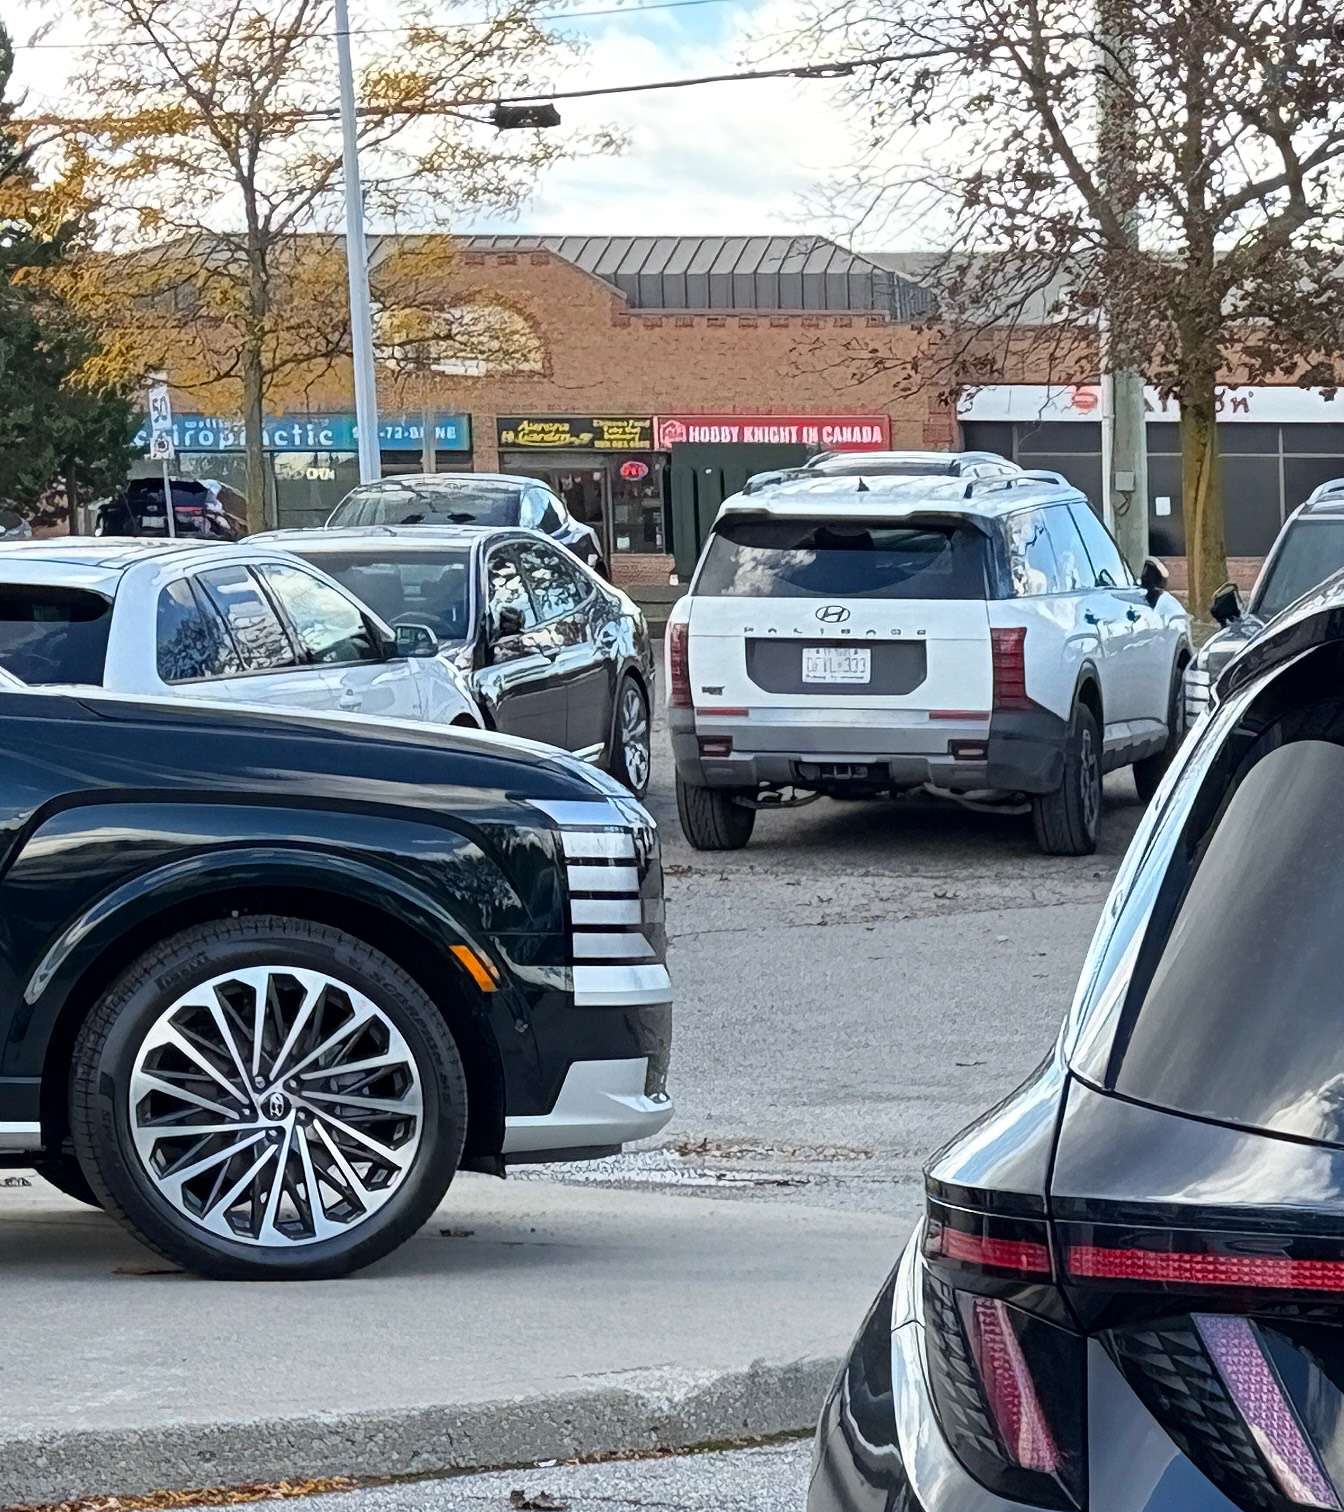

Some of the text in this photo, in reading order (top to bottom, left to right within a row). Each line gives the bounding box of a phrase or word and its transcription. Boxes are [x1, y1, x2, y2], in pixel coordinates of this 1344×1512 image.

[689, 426, 883, 443] HOBBY KNIGHT IN CANADA
